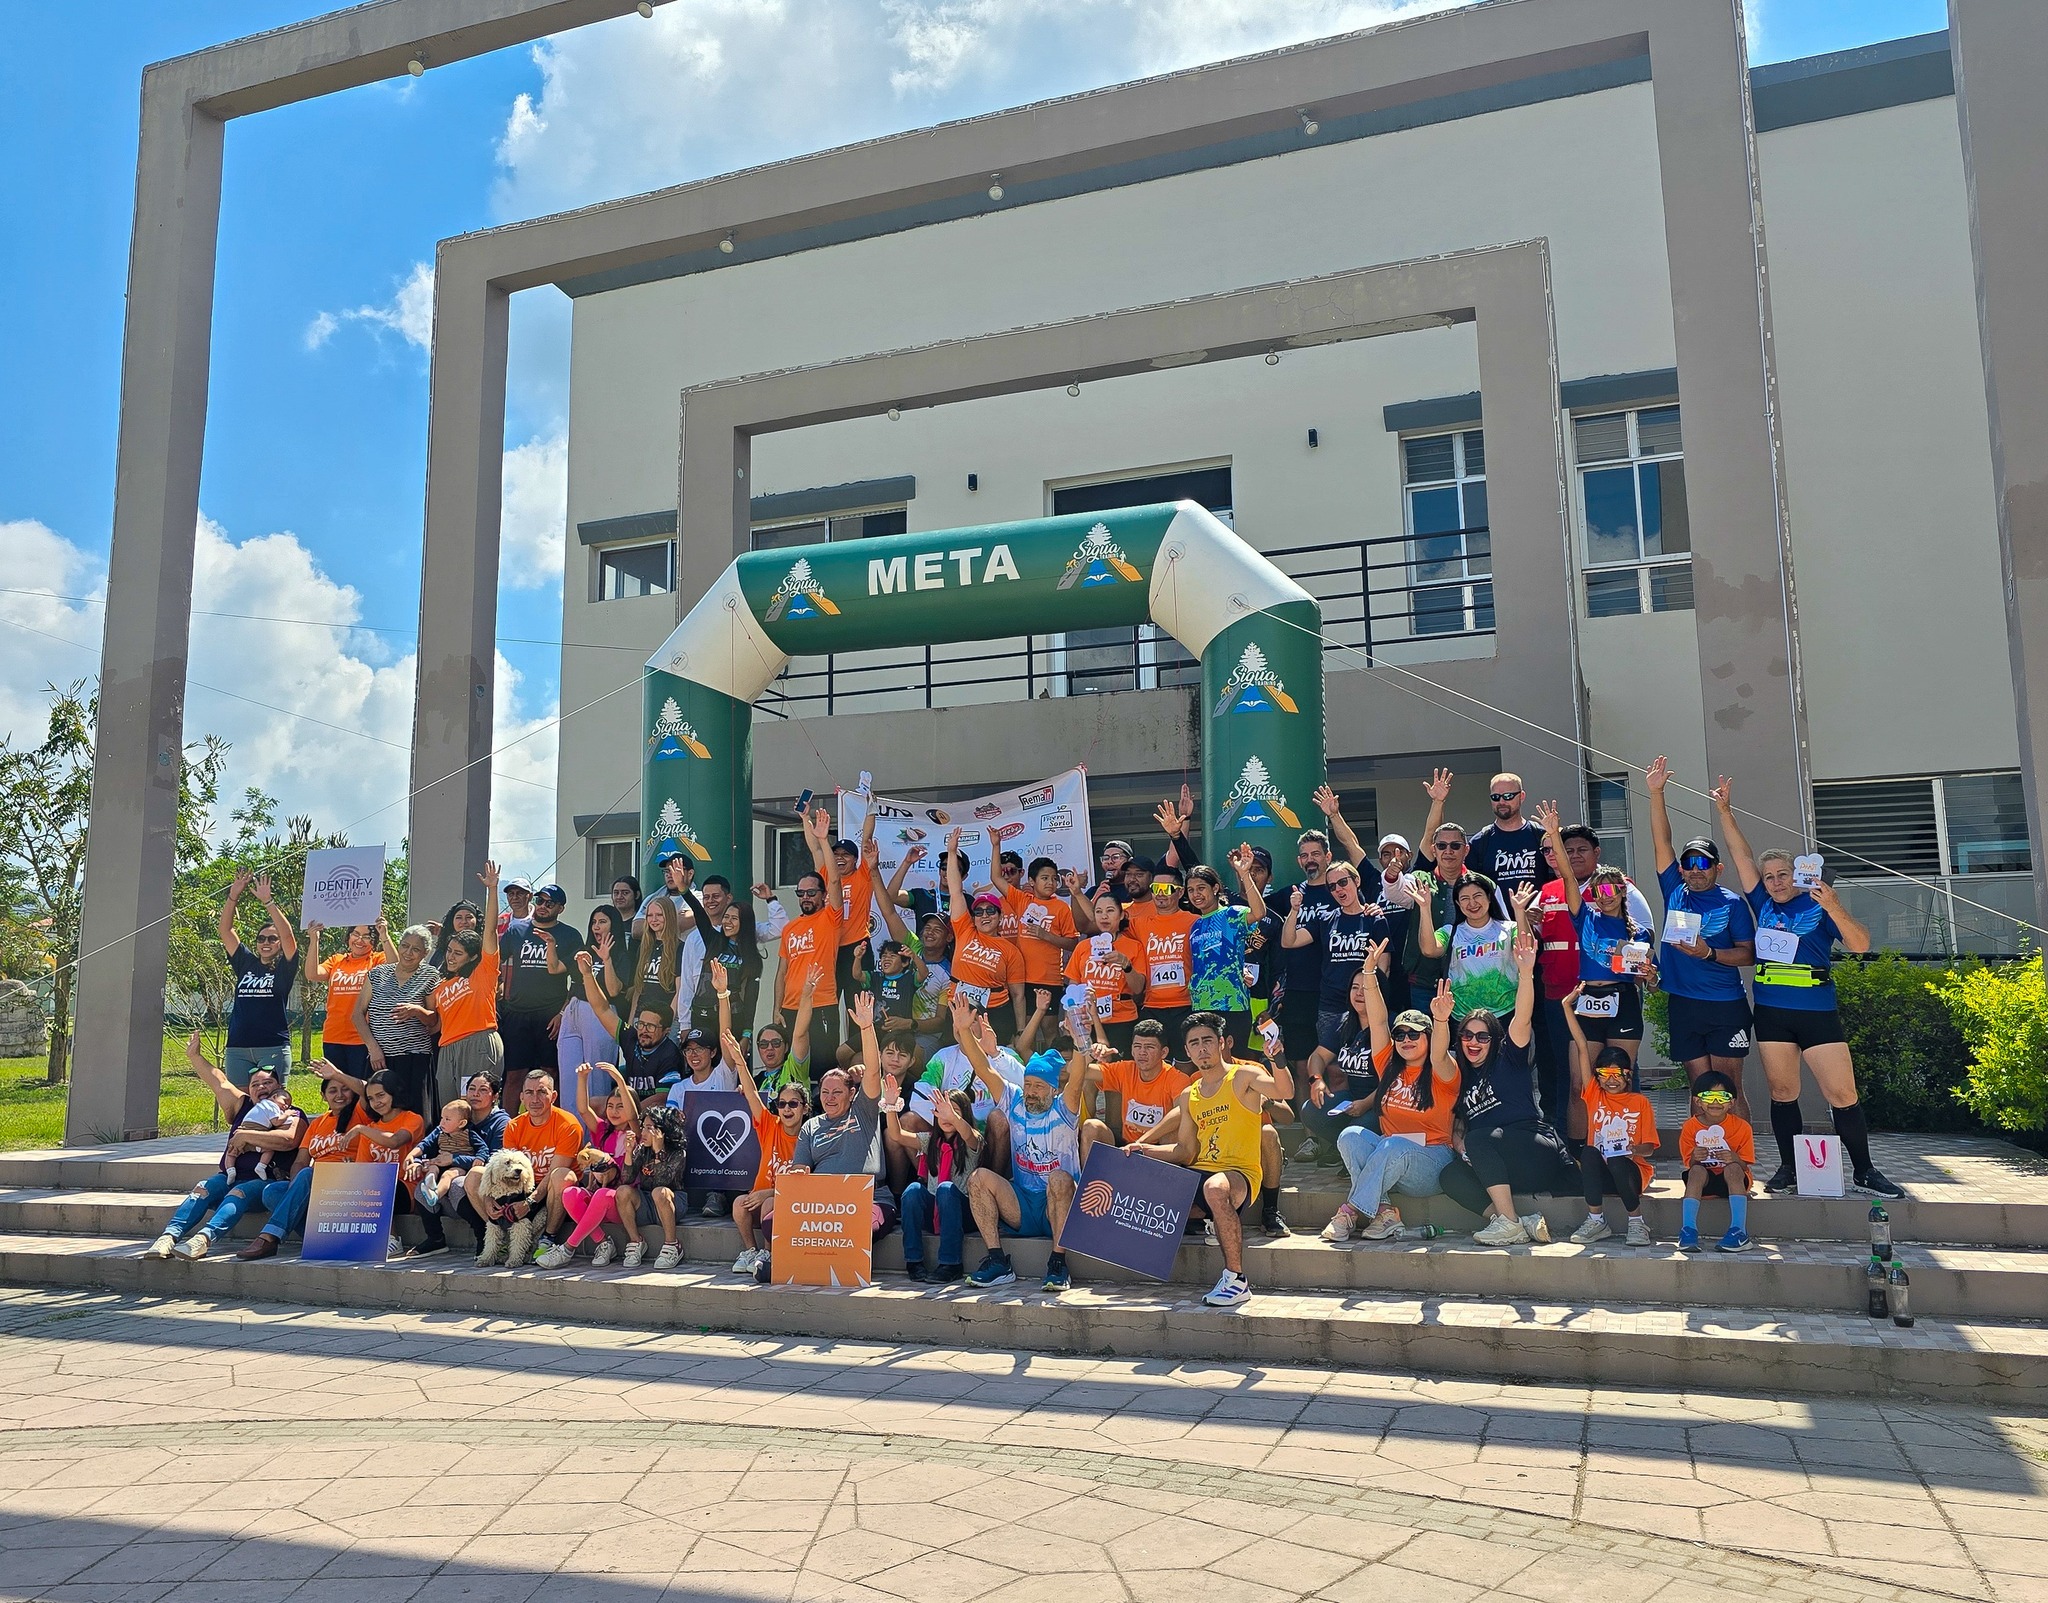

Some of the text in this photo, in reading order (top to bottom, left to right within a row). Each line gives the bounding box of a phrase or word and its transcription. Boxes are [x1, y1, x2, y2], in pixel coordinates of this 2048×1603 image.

[1073, 540, 1121, 563] Sigua
[868, 544, 1021, 596] META
[777, 574, 820, 597] Sigua
[1228, 664, 1278, 689] Sigua
[652, 717, 692, 739] Sigua
[1229, 778, 1280, 803] Sigua
[651, 818, 692, 841] Sigua
[314, 878, 373, 893] IDENTIFY
[313, 890, 373, 900] solutions
[1455, 940, 1505, 960] FENAPIN
[1757, 933, 1789, 956] 062
[1155, 971, 1178, 982] 140
[1097, 1003, 1111, 1015] 06
[1585, 999, 1611, 1012] 056
[1132, 1109, 1156, 1124] 073
[1202, 1104, 1230, 1119] BELTRAN
[691, 1167, 717, 1176] Llegando
[724, 1168, 748, 1176] Corazón
[1027, 1159, 1061, 1172] MOUNTAIN
[791, 1202, 857, 1215] CUIDADO
[1114, 1191, 1180, 1224] MISIÓN
[800, 1220, 843, 1233] AMOR
[1110, 1204, 1176, 1235] IDENTIDAD
[317, 1222, 378, 1234] DEL PLAN DE DIOS
[1114, 1219, 1132, 1229] Familia
[1141, 1228, 1153, 1237] cada
[791, 1237, 855, 1248] ESPERANZA
